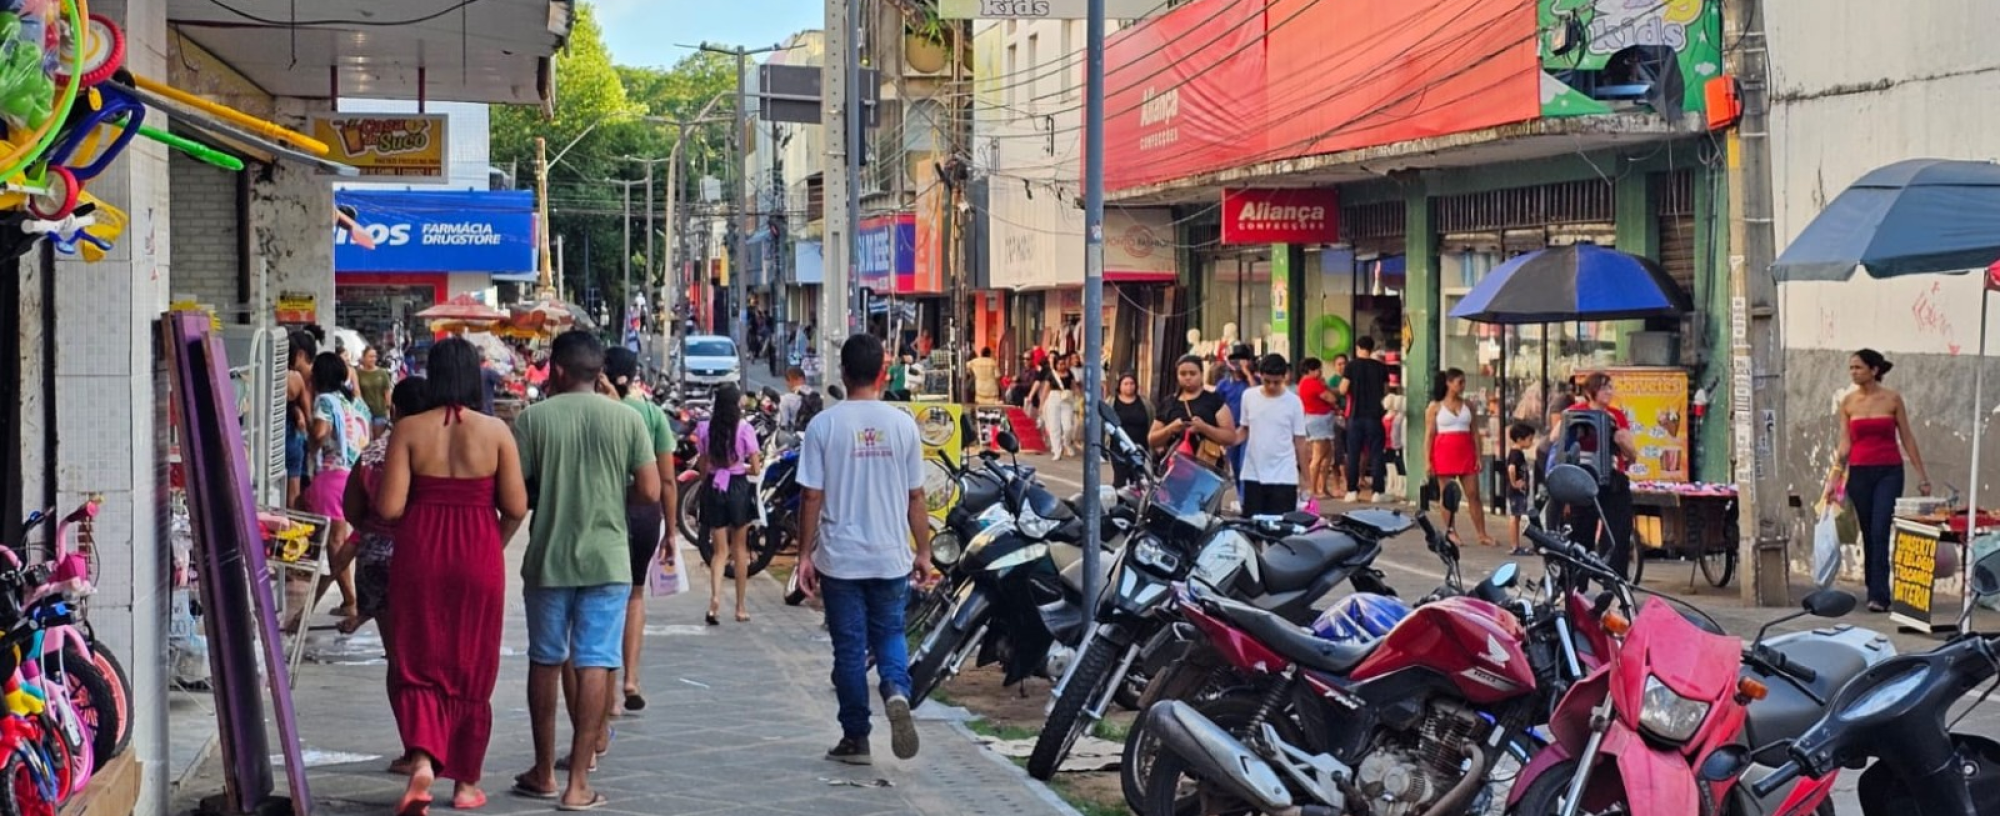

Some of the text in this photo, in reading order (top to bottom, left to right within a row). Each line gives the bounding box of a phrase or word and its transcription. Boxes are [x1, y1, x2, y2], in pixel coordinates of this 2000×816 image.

[1593, 17, 1683, 49] kids
[1140, 86, 1178, 128] Aliança
[378, 131, 427, 153] Suco
[1238, 201, 1325, 224] Aliança
[421, 221, 493, 235] FARMÁCIA
[421, 234, 501, 245] DRUGSTORE
